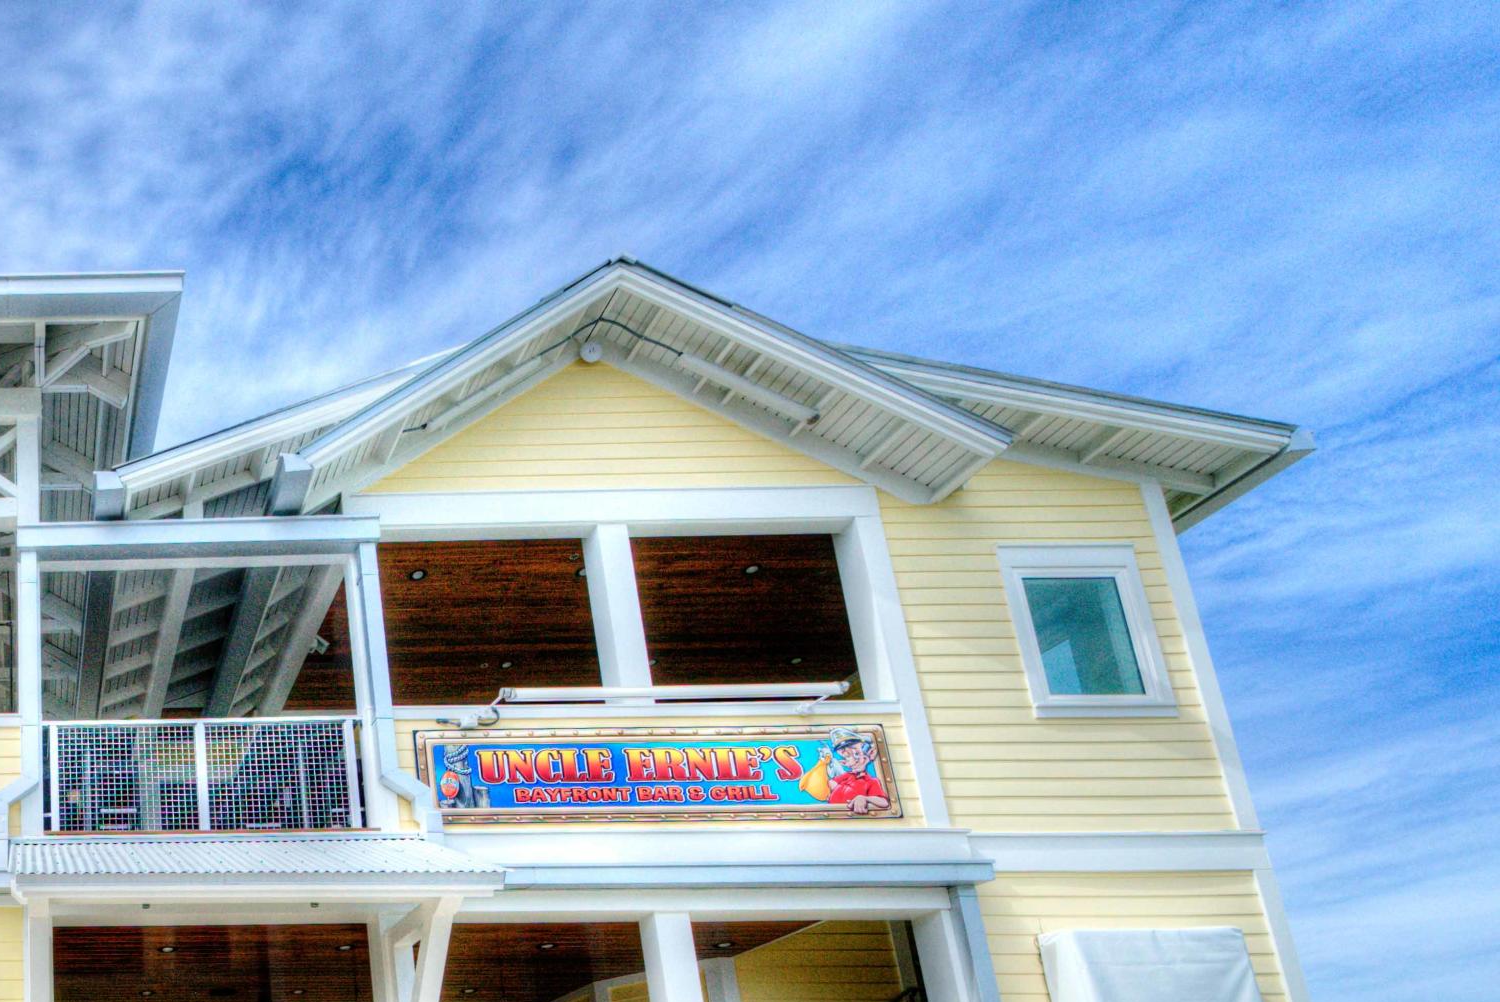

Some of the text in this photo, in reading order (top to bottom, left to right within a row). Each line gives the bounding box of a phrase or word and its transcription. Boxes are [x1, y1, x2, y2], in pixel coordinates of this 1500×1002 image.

[476, 746, 802, 783] UNCLE ERNIE'S
[514, 785, 778, 803] BAYFRONT BAR & GRILL
